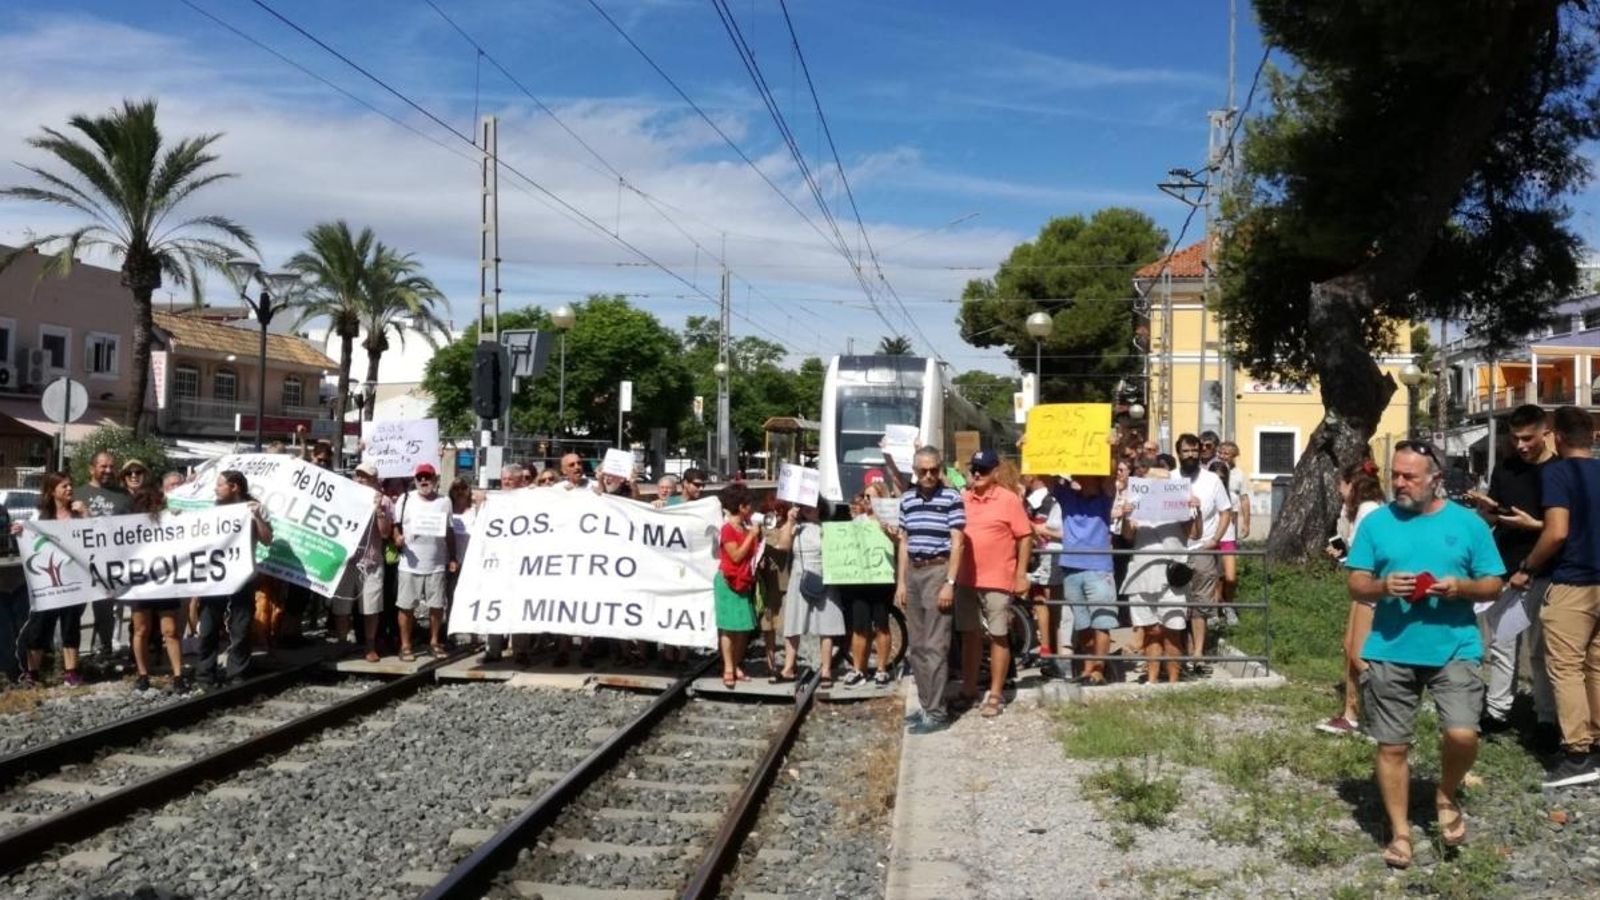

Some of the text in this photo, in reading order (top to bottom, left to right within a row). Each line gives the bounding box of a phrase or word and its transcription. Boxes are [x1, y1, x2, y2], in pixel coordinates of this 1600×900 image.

[406, 440, 424, 454] 15
[1074, 431, 1107, 458] 15
[293, 467, 311, 490] de
[311, 472, 335, 502] los
[1132, 484, 1149, 494] NO
[113, 523, 184, 546] defensa
[191, 516, 210, 538] de
[216, 516, 242, 534] los
[486, 513, 687, 548] S.O.S. CLIMA
[519, 554, 637, 578] METRO
[863, 547, 886, 570] 15
[468, 599, 705, 631] 15 MINUTS JA!
